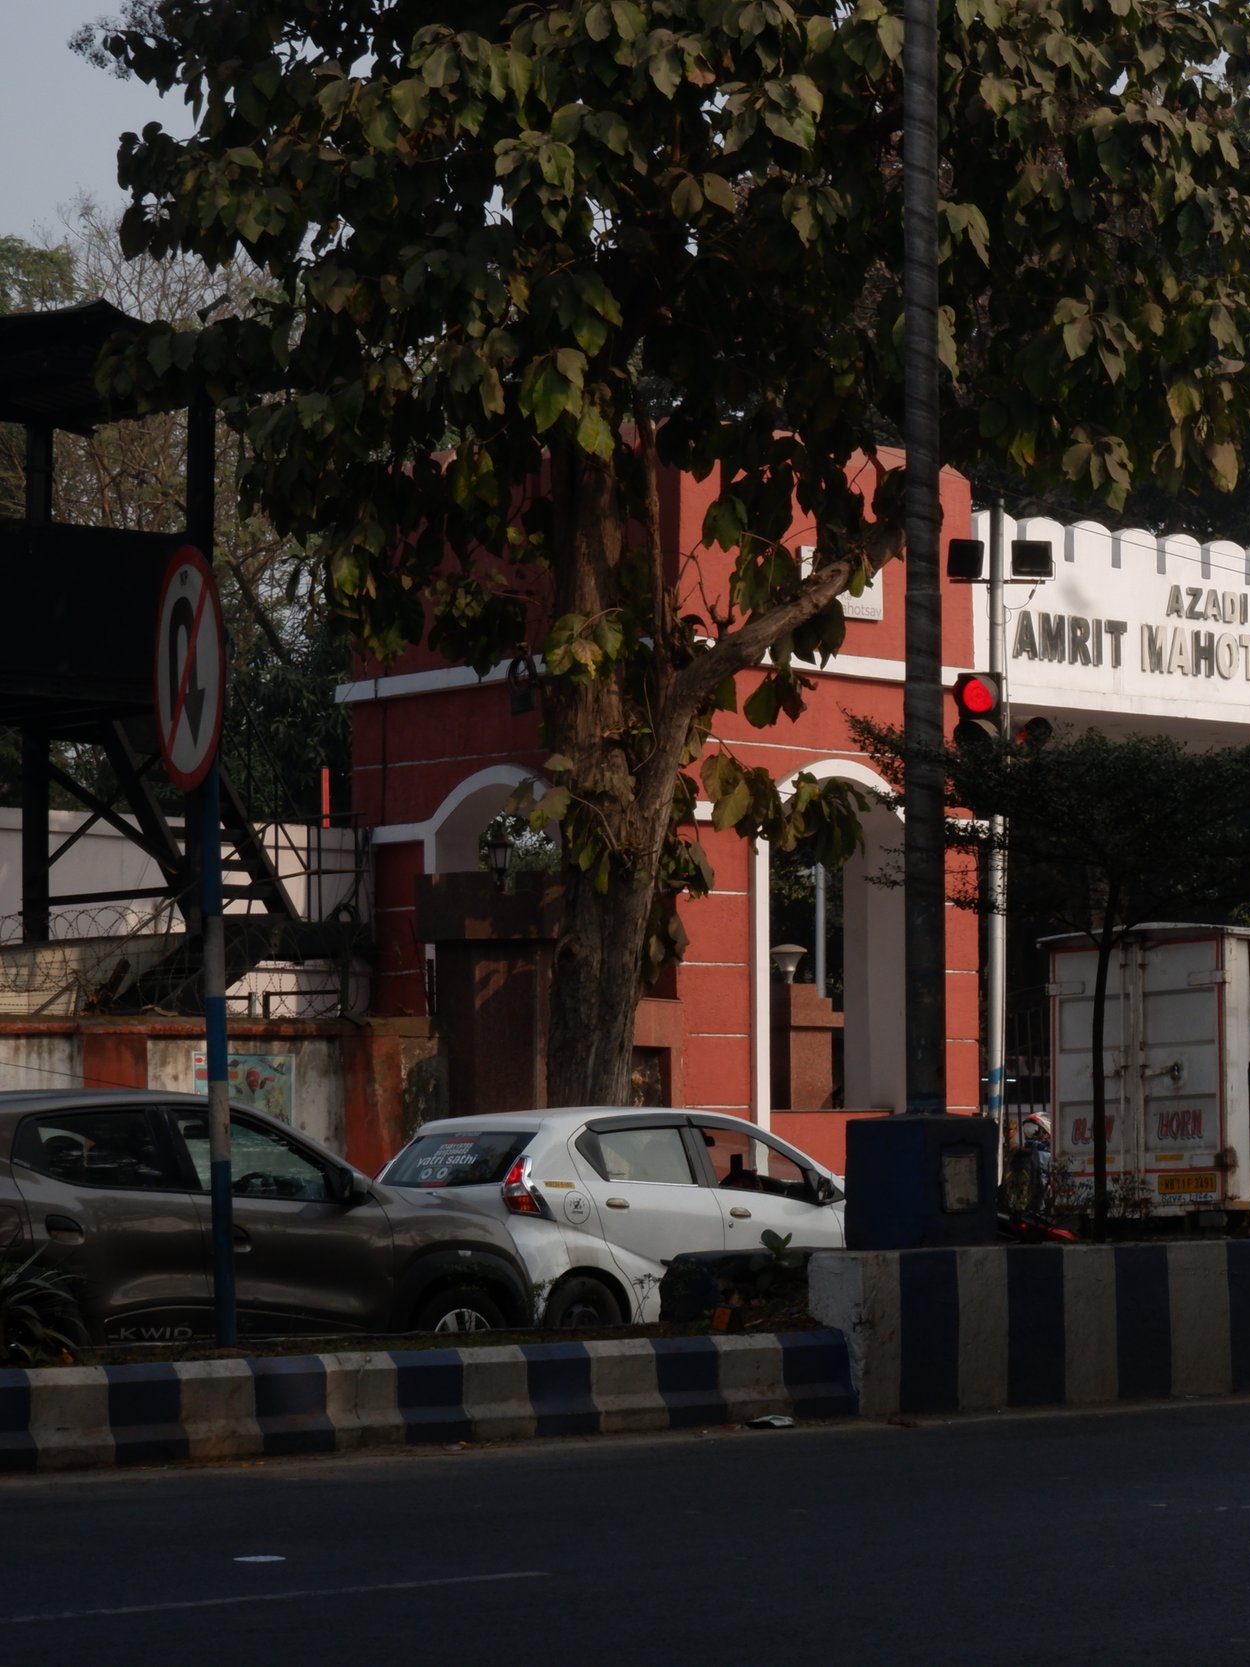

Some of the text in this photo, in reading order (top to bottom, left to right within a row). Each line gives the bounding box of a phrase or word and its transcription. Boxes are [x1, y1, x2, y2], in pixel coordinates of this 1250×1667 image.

[843, 601, 882, 617] ahotsav
[1166, 584, 1249, 625] AZADI
[1012, 610, 1128, 668] AMRIT
[1071, 1109, 1204, 1145] BLW HORN
[416, 1154, 478, 1168] yatri sathi
[120, 1327, 193, 1340] KWID
